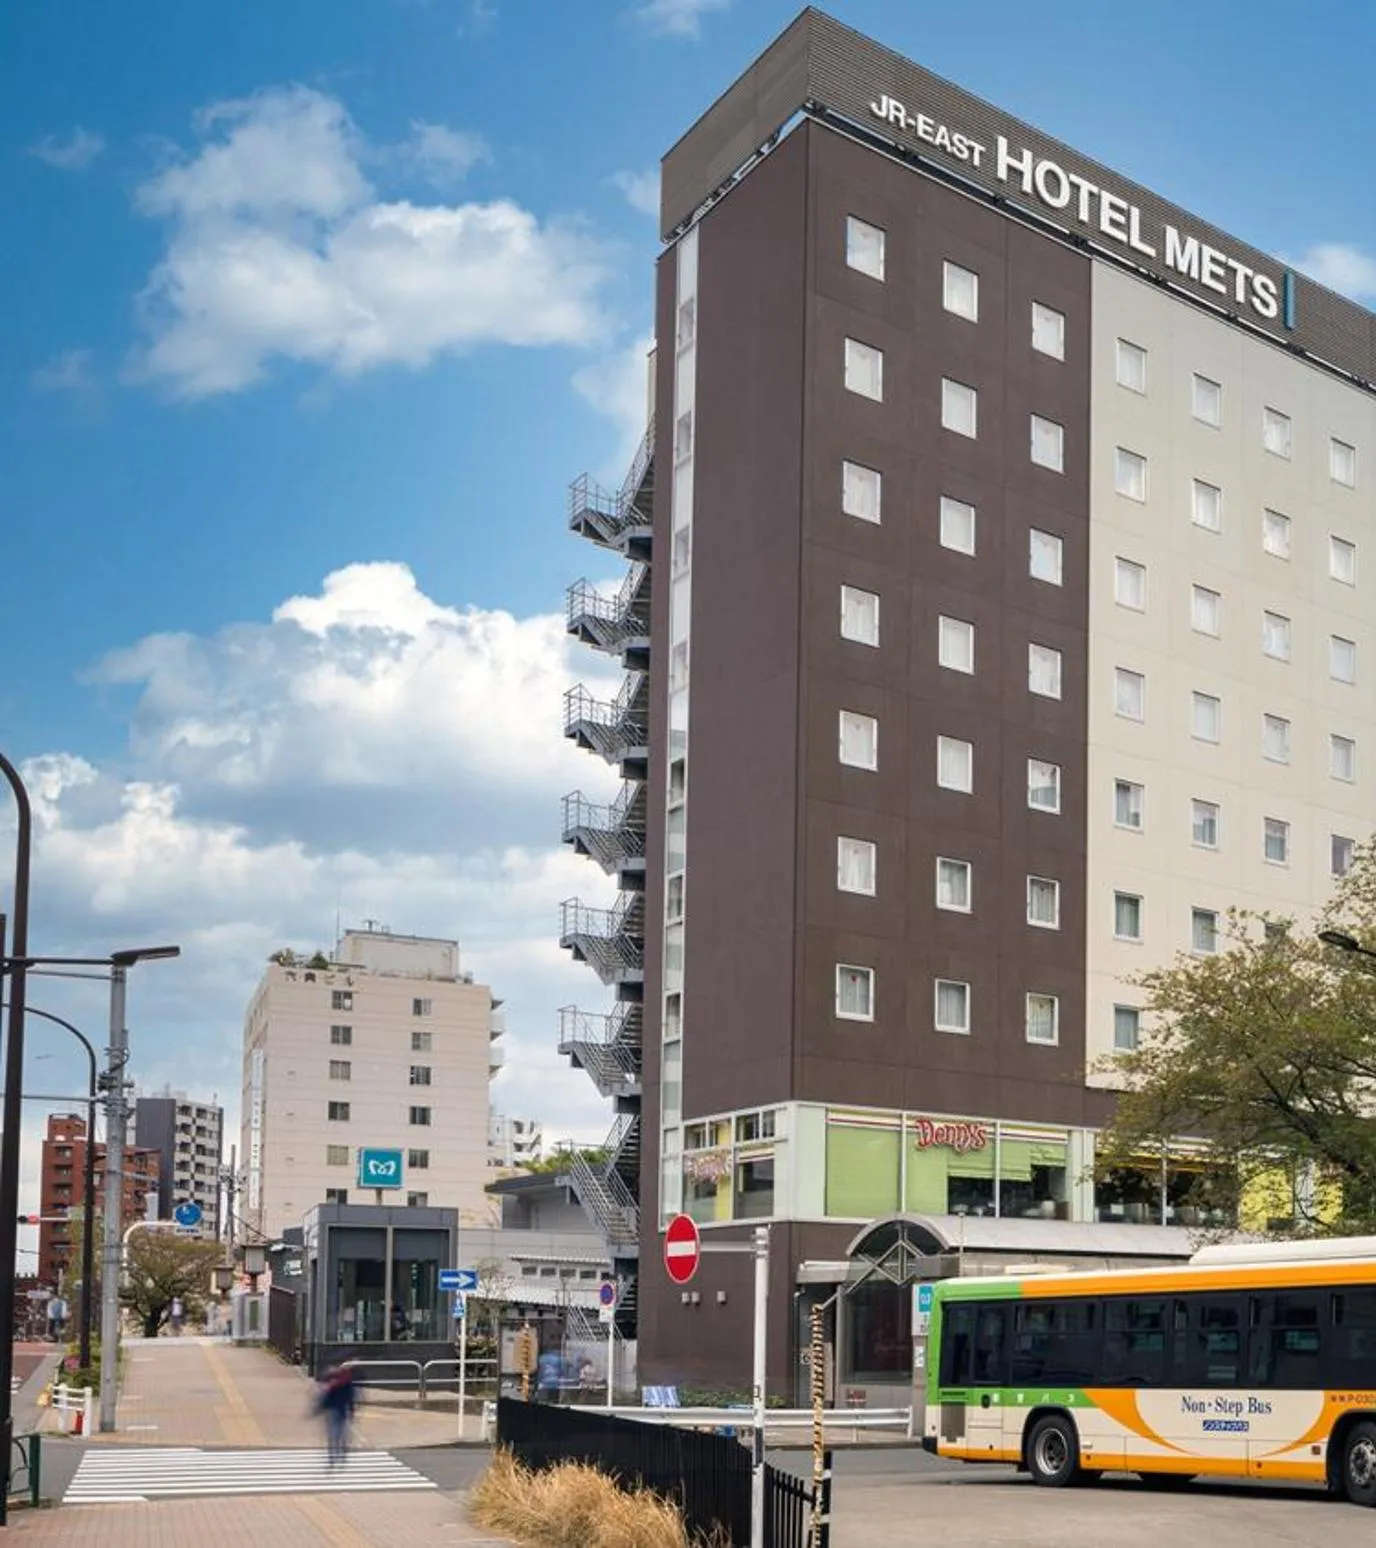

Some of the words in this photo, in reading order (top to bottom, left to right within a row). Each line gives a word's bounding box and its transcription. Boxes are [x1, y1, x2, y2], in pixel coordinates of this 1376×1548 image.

[870, 95, 986, 167] JR-EAST
[996, 135, 1157, 257] HOTEL
[1164, 224, 1278, 319] METS
[1248, 1397, 1272, 1413] Bus
